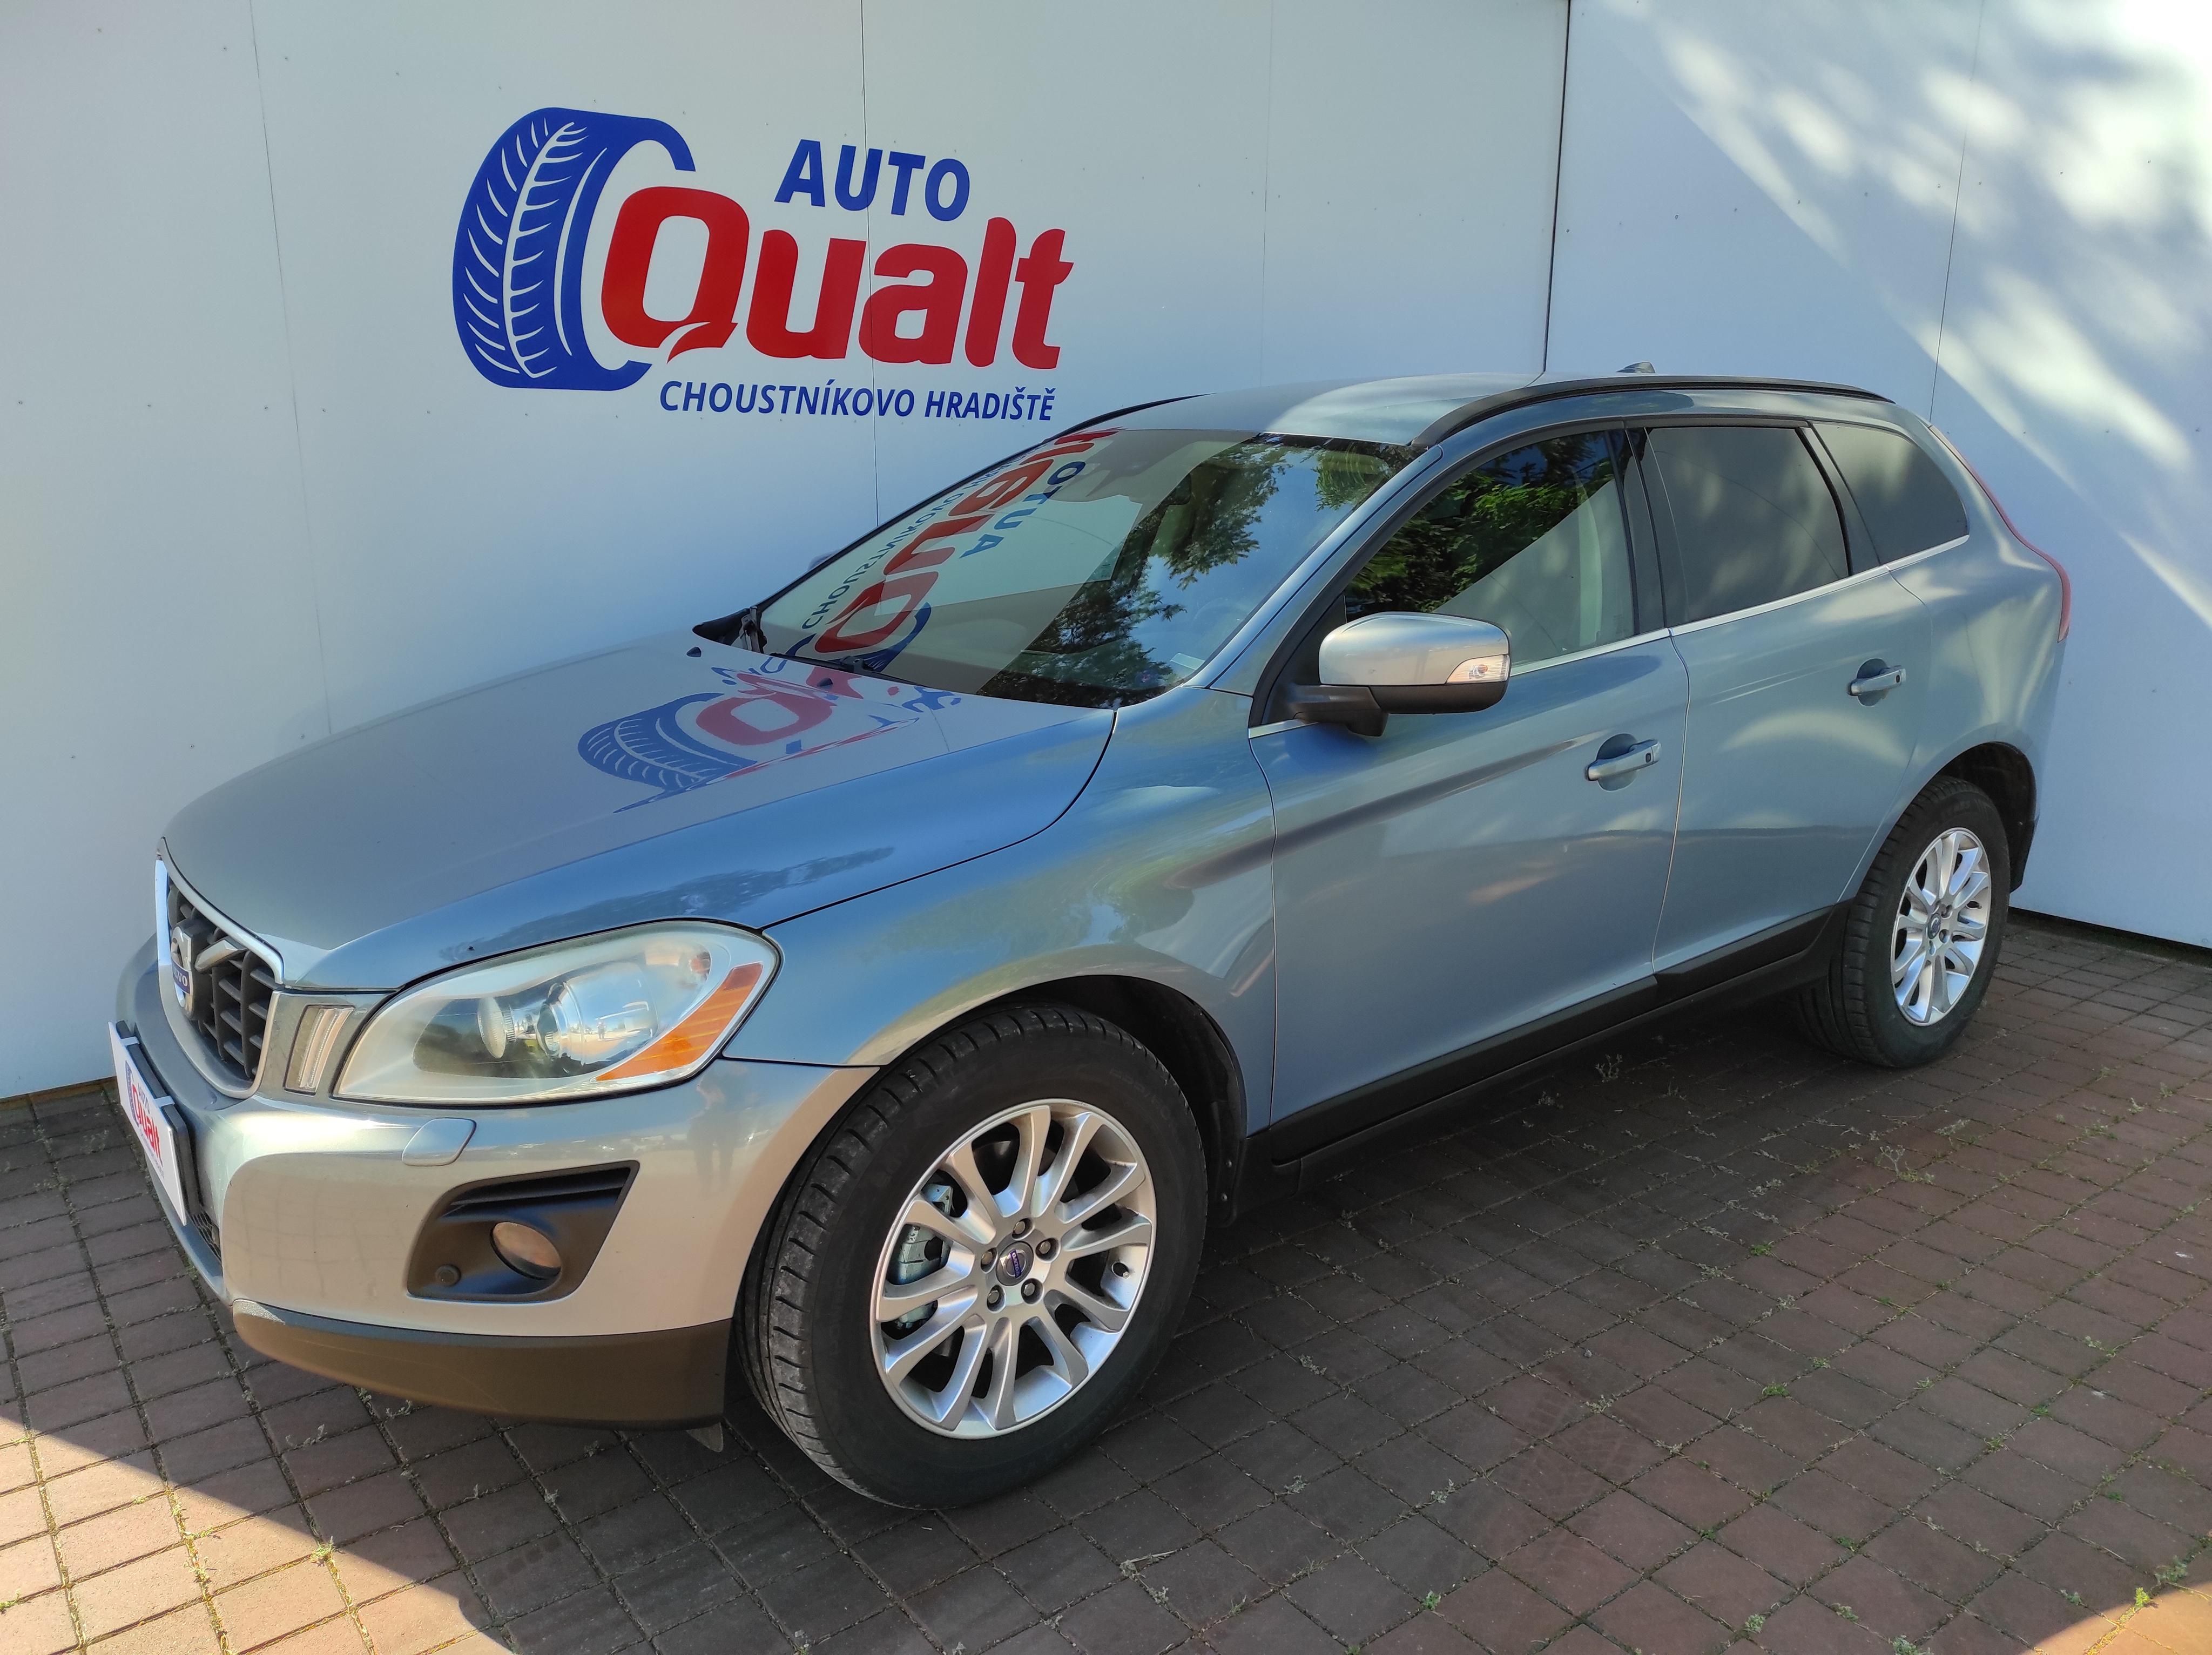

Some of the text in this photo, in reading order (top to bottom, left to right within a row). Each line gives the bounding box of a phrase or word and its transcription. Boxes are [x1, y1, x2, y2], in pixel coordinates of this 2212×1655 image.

[774, 139, 970, 222] AUTO
[601, 186, 1074, 369] Qualt
[659, 379, 1056, 421] CHOUSTNÍKOVO HRADIŠTĚ
